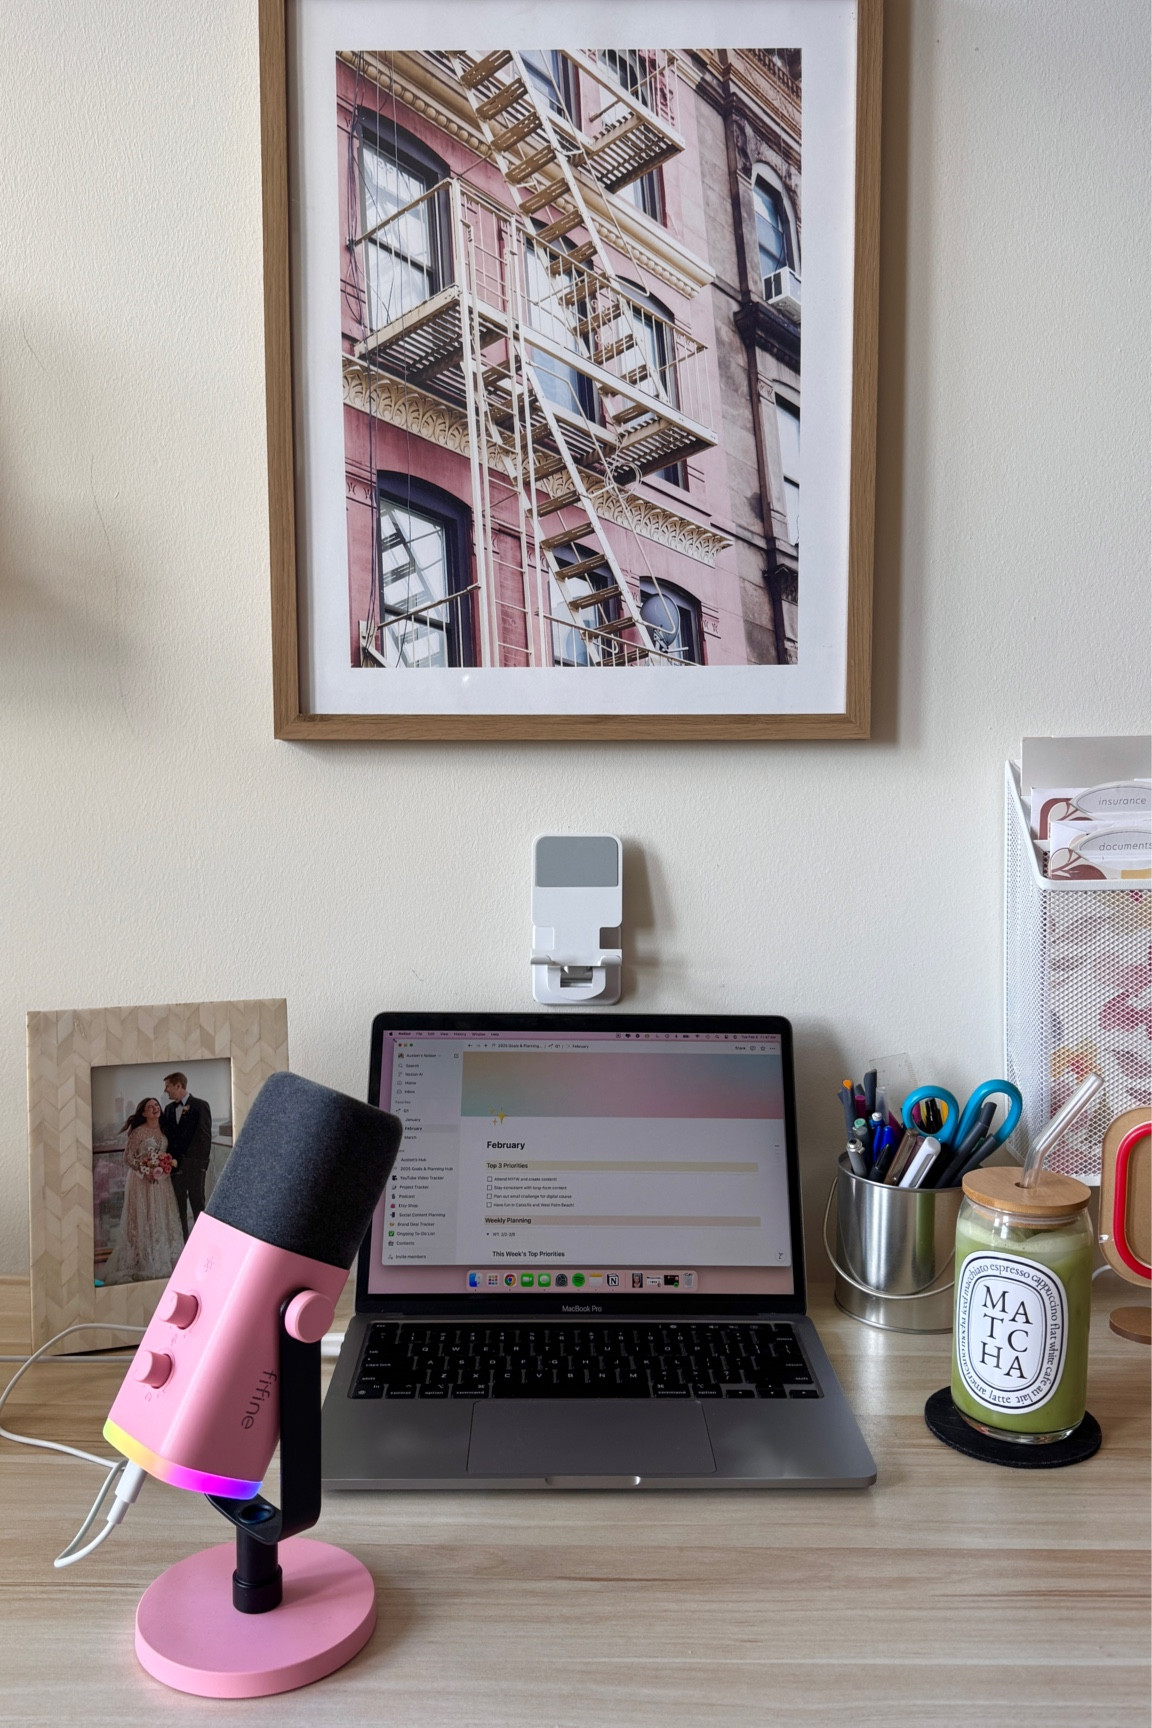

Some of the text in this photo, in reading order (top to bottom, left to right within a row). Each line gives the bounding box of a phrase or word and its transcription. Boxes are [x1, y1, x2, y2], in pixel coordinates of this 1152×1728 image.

[1098, 796, 1147, 806] insurance
[486, 1141, 526, 1151] February
[964, 1263, 1060, 1405] macchiato espresso cappuccino flat white cafe au lait
[961, 1348, 987, 1395] americano
[241, 1369, 278, 1430] fifine
[988, 1390, 1011, 1404] latte
